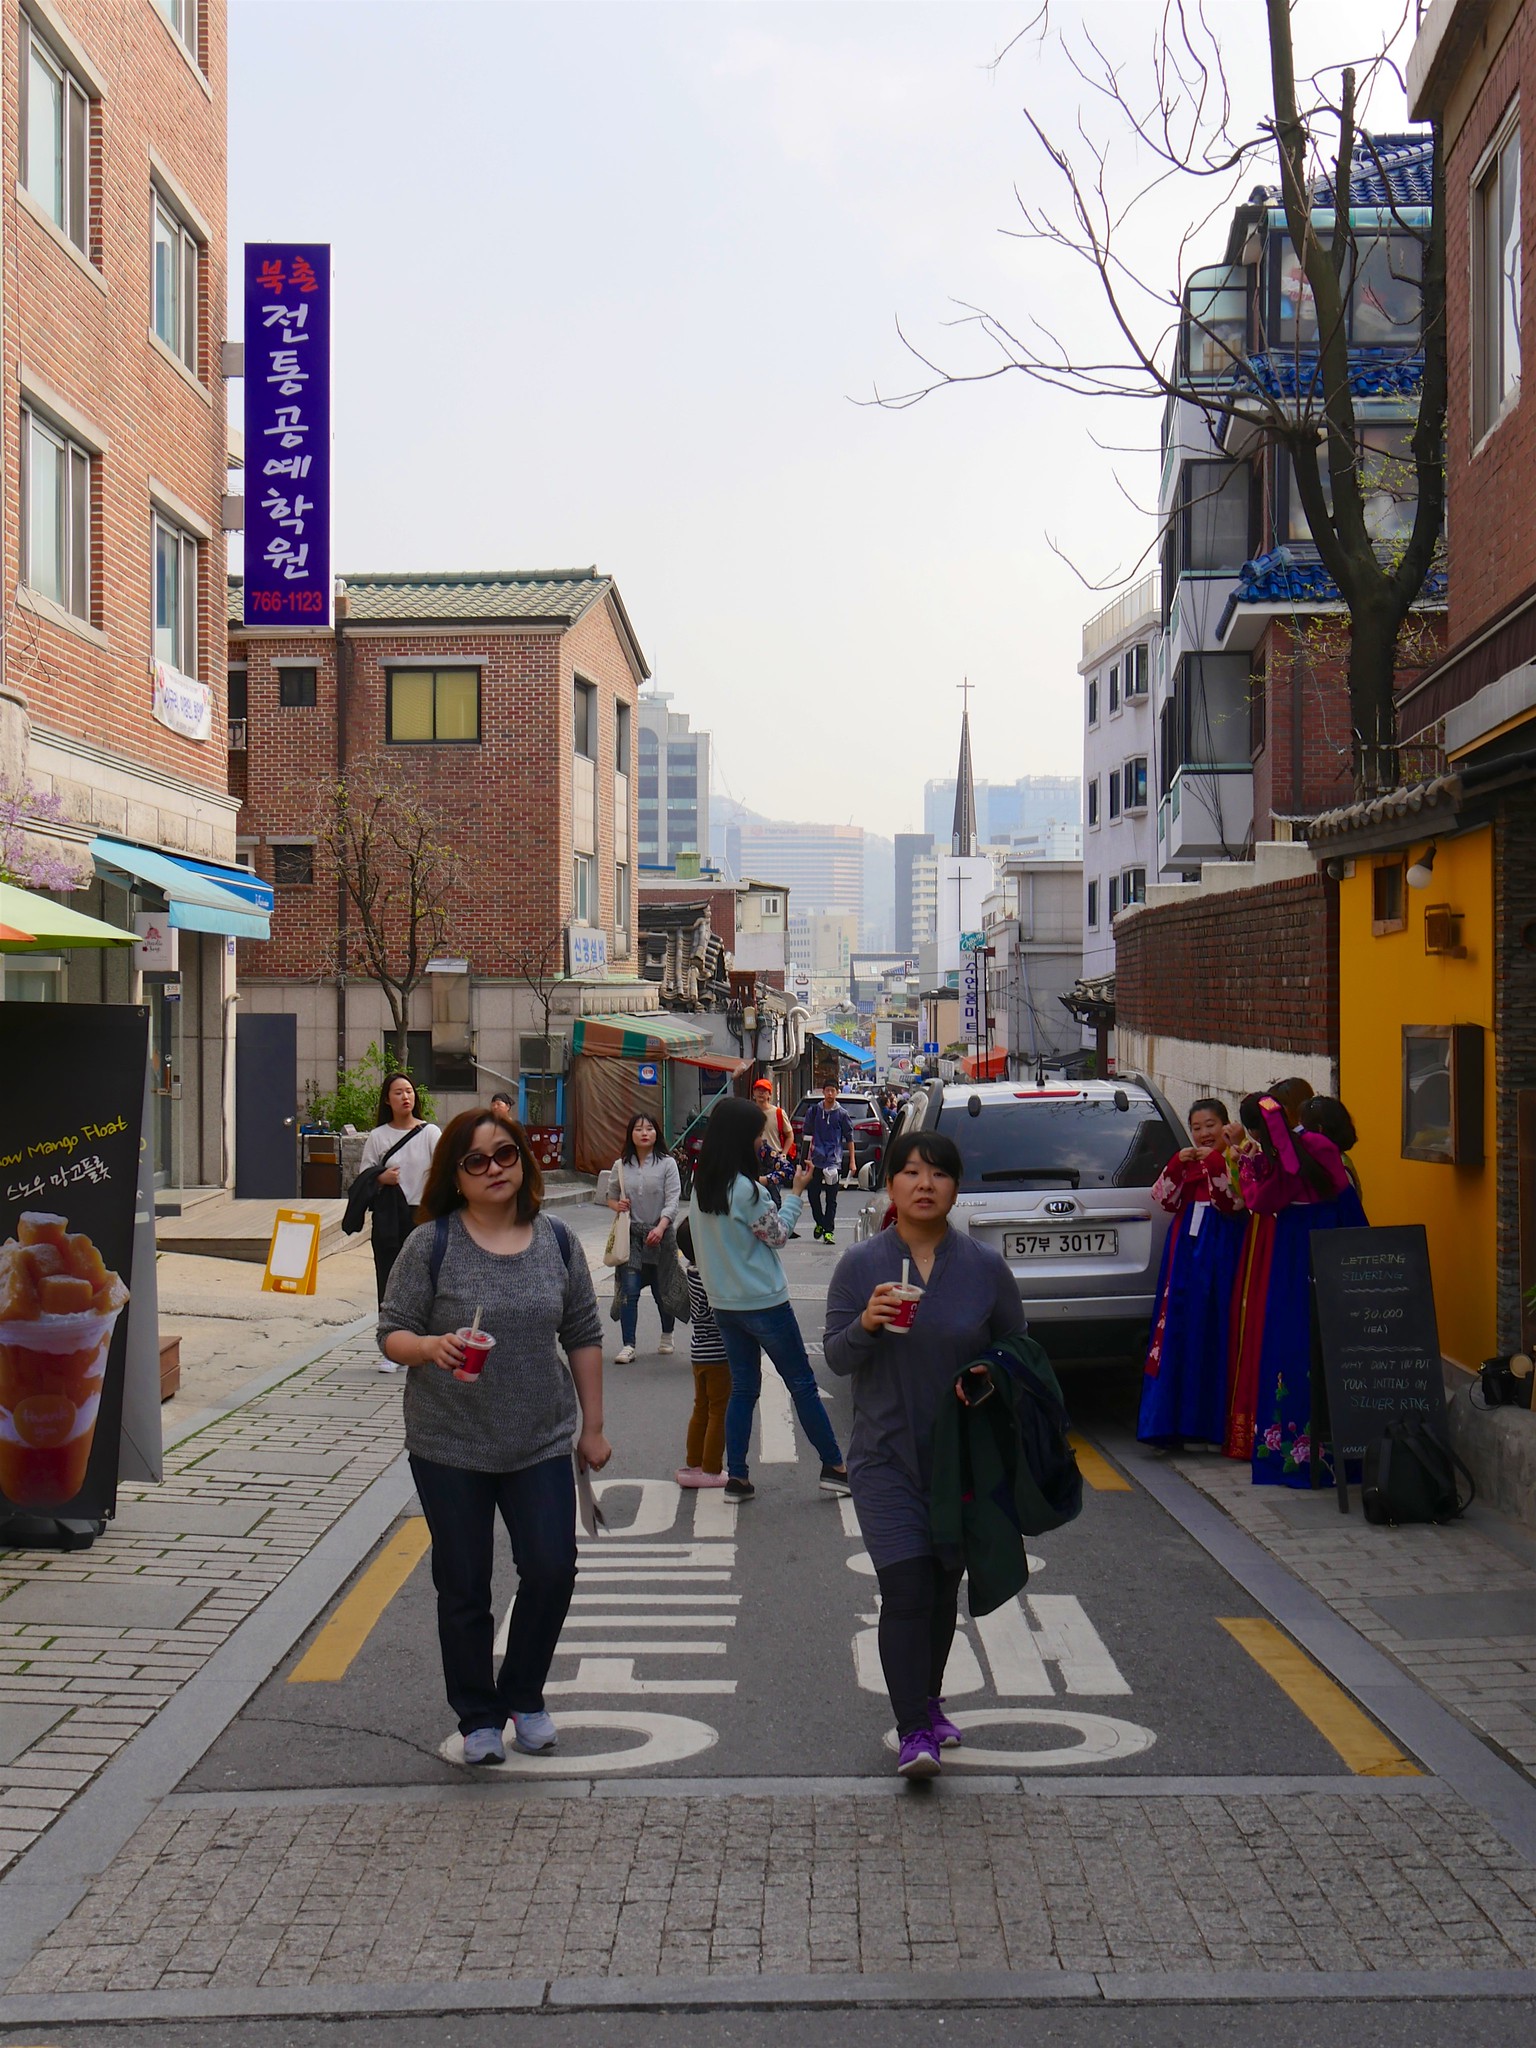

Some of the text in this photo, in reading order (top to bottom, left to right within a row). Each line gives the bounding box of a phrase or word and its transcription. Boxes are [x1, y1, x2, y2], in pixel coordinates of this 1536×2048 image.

[256, 256, 318, 294] 북촌
[261, 303, 314, 580] 전통공예학원
[251, 591, 323, 613] 766-1123
[574, 936, 604, 963] 신광설비
[27, 1135, 79, 1158] Mango
[80, 1115, 129, 1141] Float
[7, 1175, 46, 1201] 스노우
[1048, 1202, 1071, 1212] KIA
[1015, 1234, 1106, 1254] 57부 3017
[1340, 1253, 1406, 1265] LETTERING
[1342, 1270, 1404, 1281] SILVERING
[1342, 1378, 1368, 1390] YOUR
[1350, 1396, 1394, 1410] SILVER
